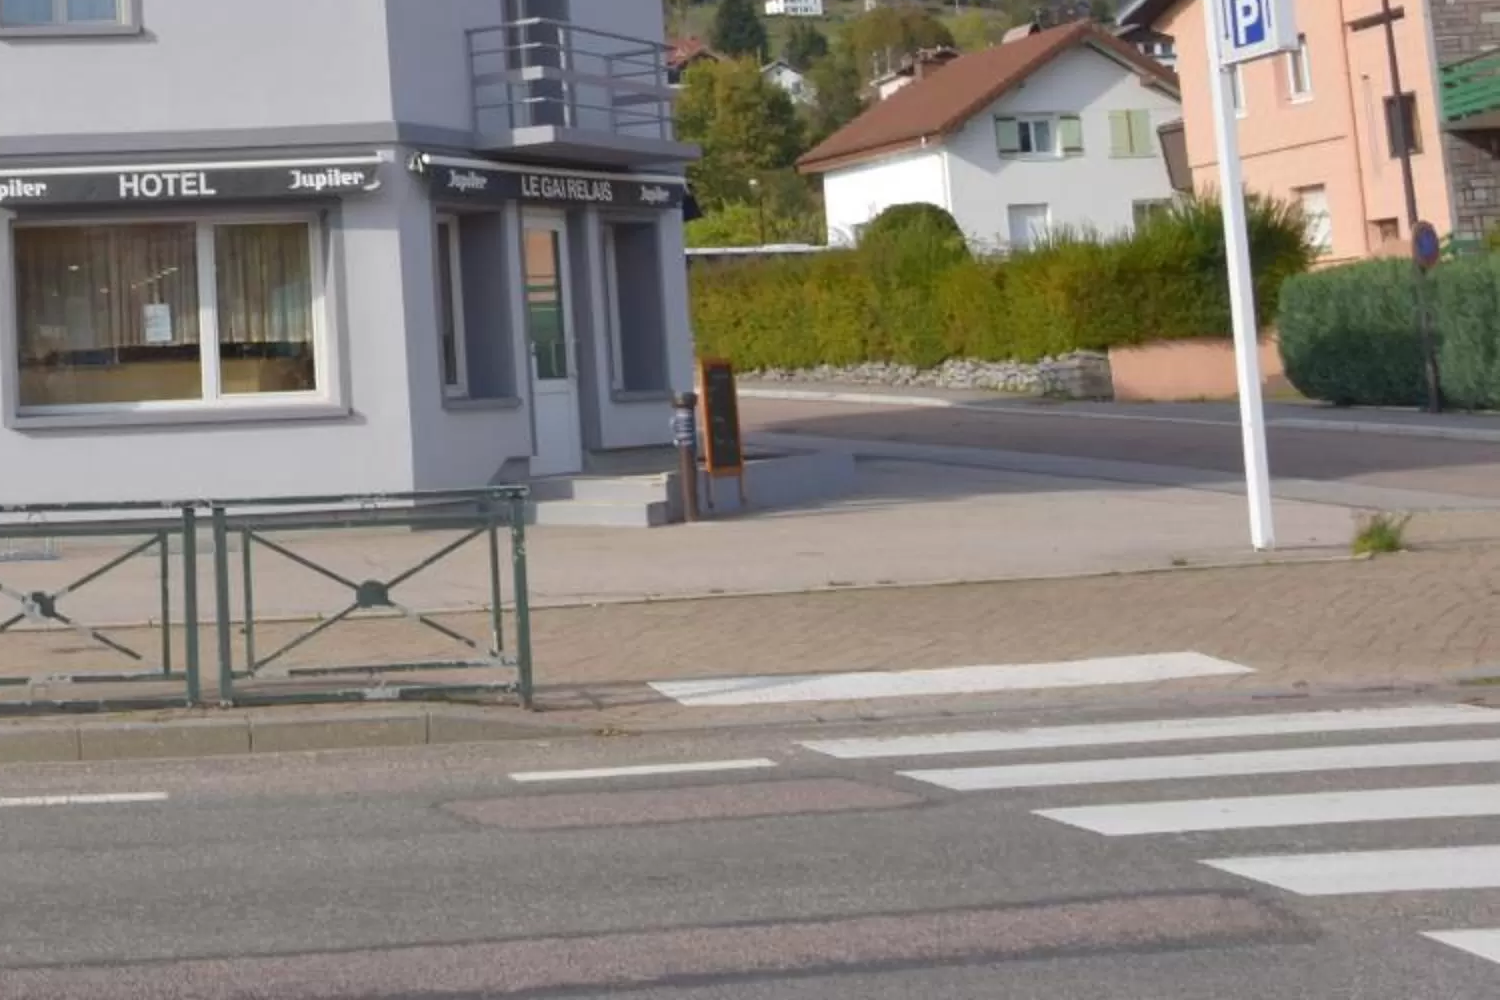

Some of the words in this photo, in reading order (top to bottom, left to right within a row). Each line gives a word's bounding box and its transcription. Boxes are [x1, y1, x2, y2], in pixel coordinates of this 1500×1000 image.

[119, 172, 216, 199] HOTEL
[288, 168, 365, 191] Jupiler
[521, 174, 540, 198] LE
[541, 175, 566, 200] GAI
[567, 178, 613, 202] RELAIS
